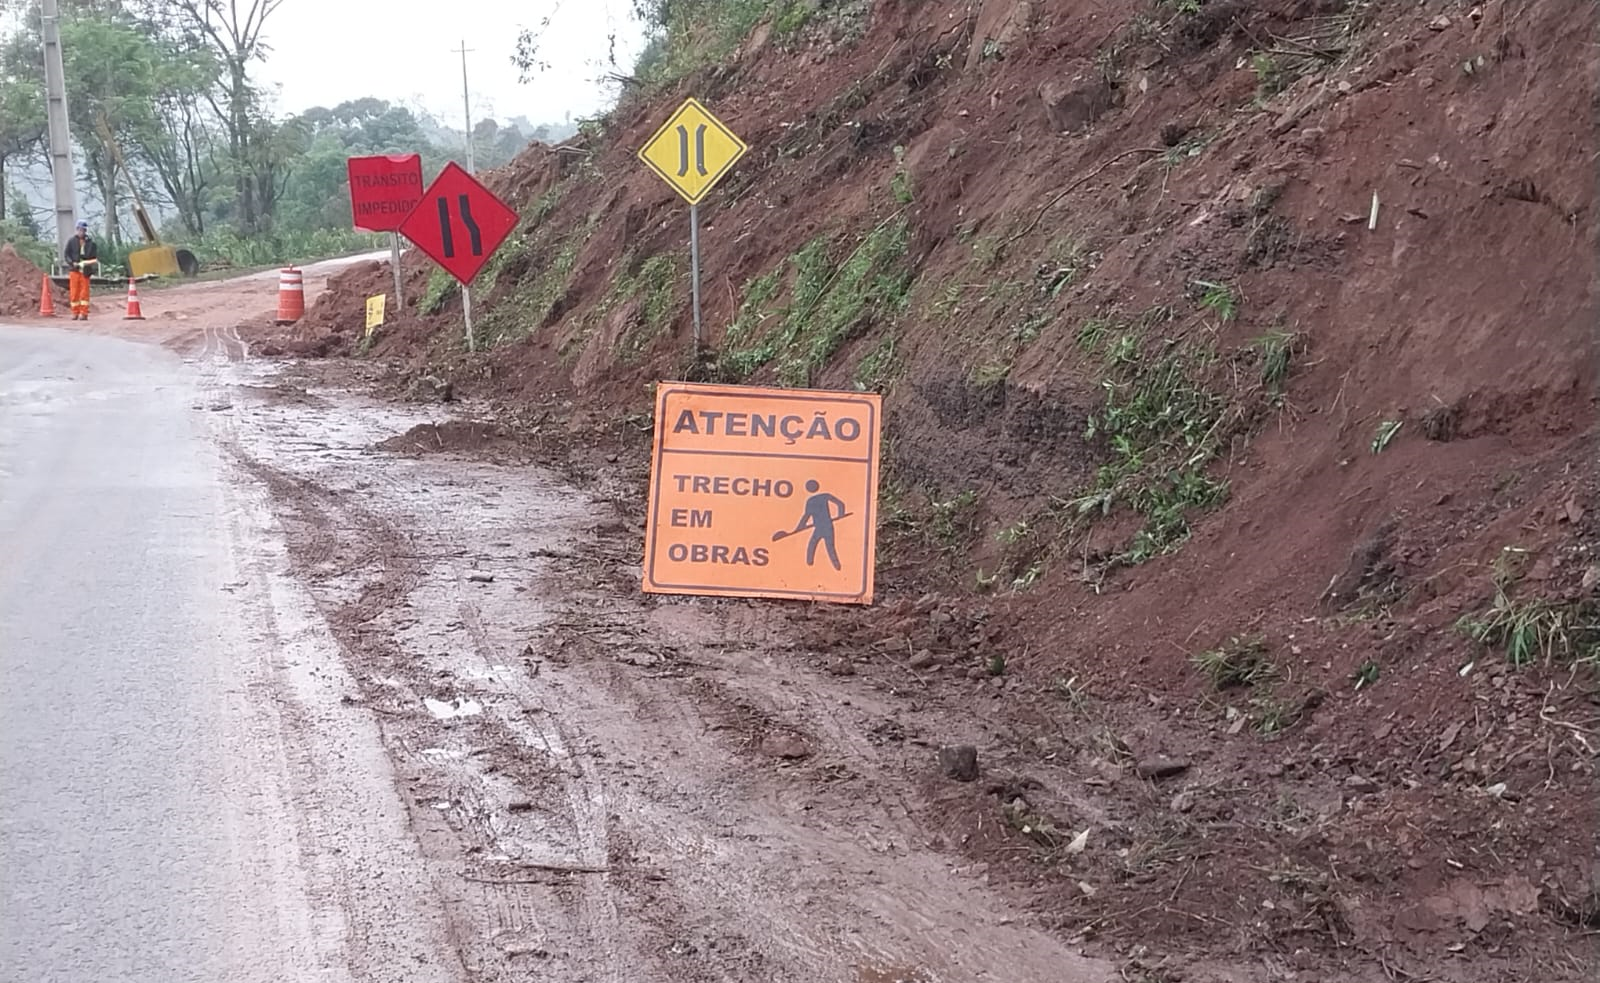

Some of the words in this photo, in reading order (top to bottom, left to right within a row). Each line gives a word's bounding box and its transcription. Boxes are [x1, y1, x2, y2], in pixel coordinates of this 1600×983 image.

[673, 410, 860, 445] ATENÇÃO
[673, 475, 794, 498] TRECHO
[671, 509, 713, 528] EM
[668, 544, 769, 566] OBRAS
